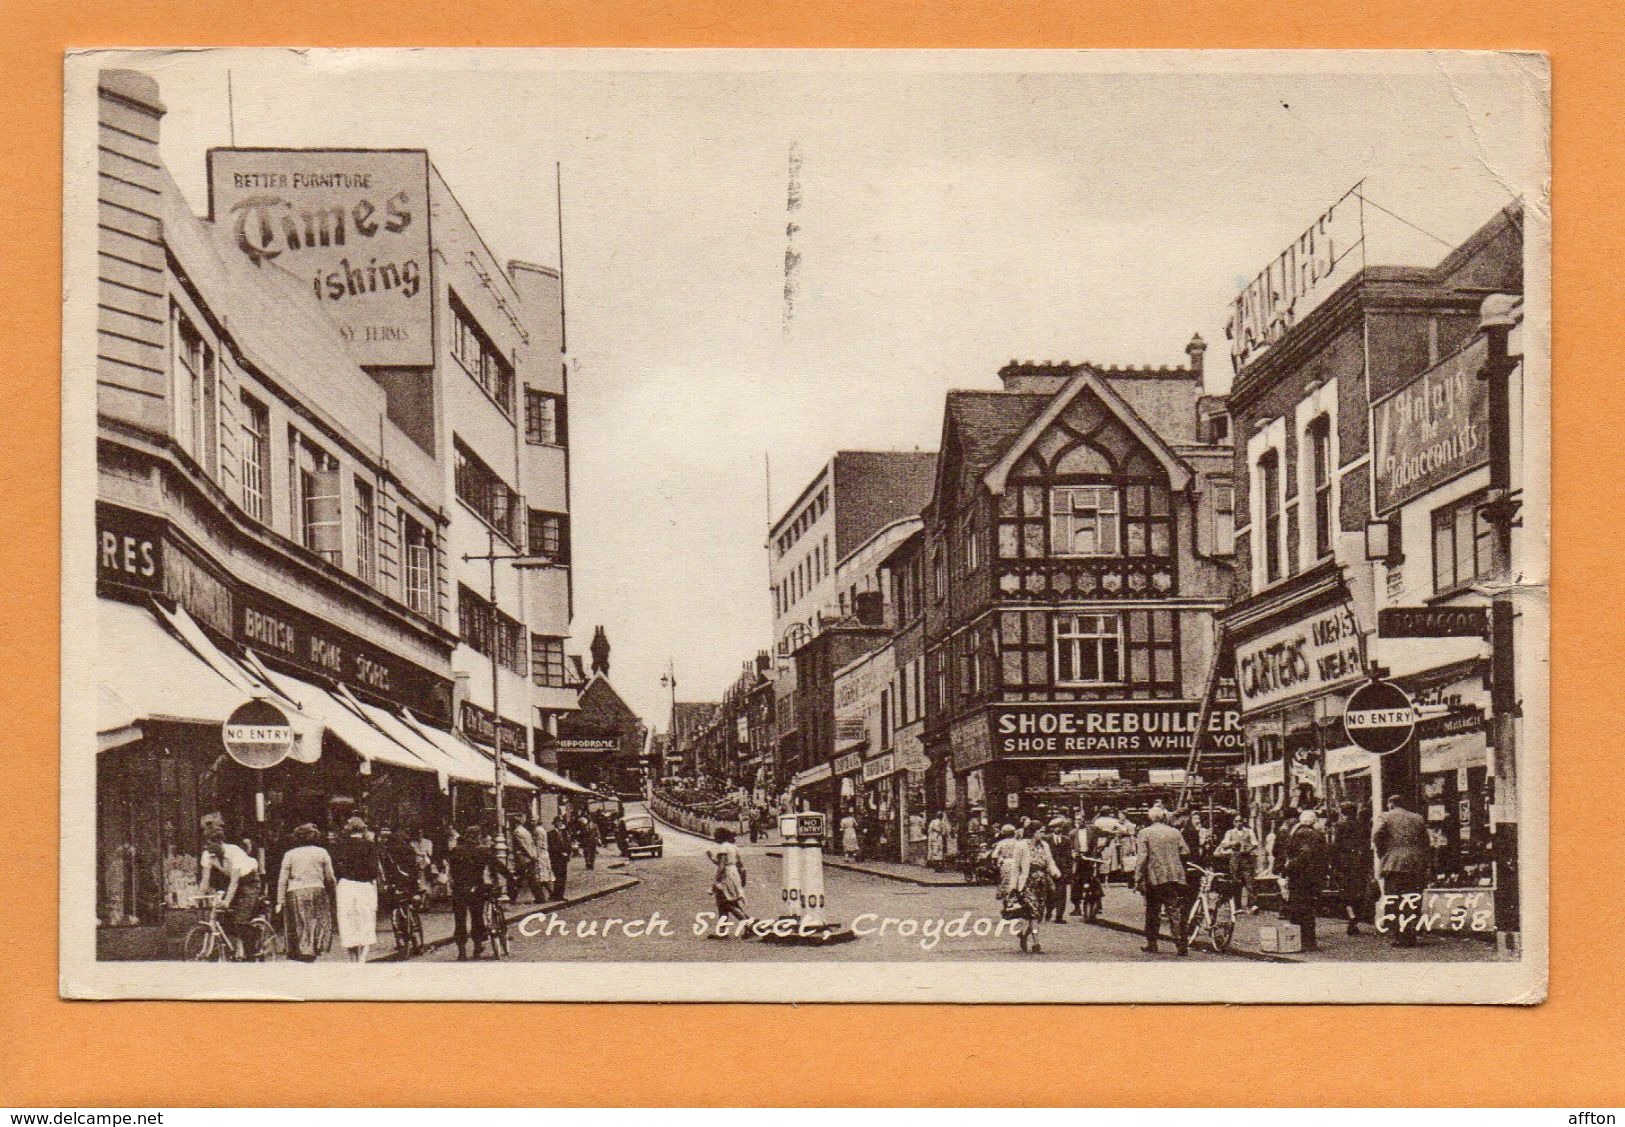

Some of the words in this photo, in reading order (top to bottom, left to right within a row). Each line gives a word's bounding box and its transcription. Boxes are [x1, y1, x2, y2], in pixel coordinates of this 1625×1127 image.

[234, 172, 288, 189] BETTER
[293, 172, 372, 189] FURNITURE
[229, 190, 412, 269] Times
[366, 325, 410, 342] TERMS
[245, 607, 295, 654] BRITISH
[311, 636, 342, 673] HOME
[1317, 647, 1359, 681] WEAR
[1348, 714, 1365, 725] NO
[1372, 712, 1411, 724] ENTRY
[227, 729, 243, 739] NO
[250, 728, 289, 740] ENTRY
[1003, 737, 1056, 752] SHOE
[1065, 735, 1140, 750] REPAIRS
[804, 819, 817, 827] NO
